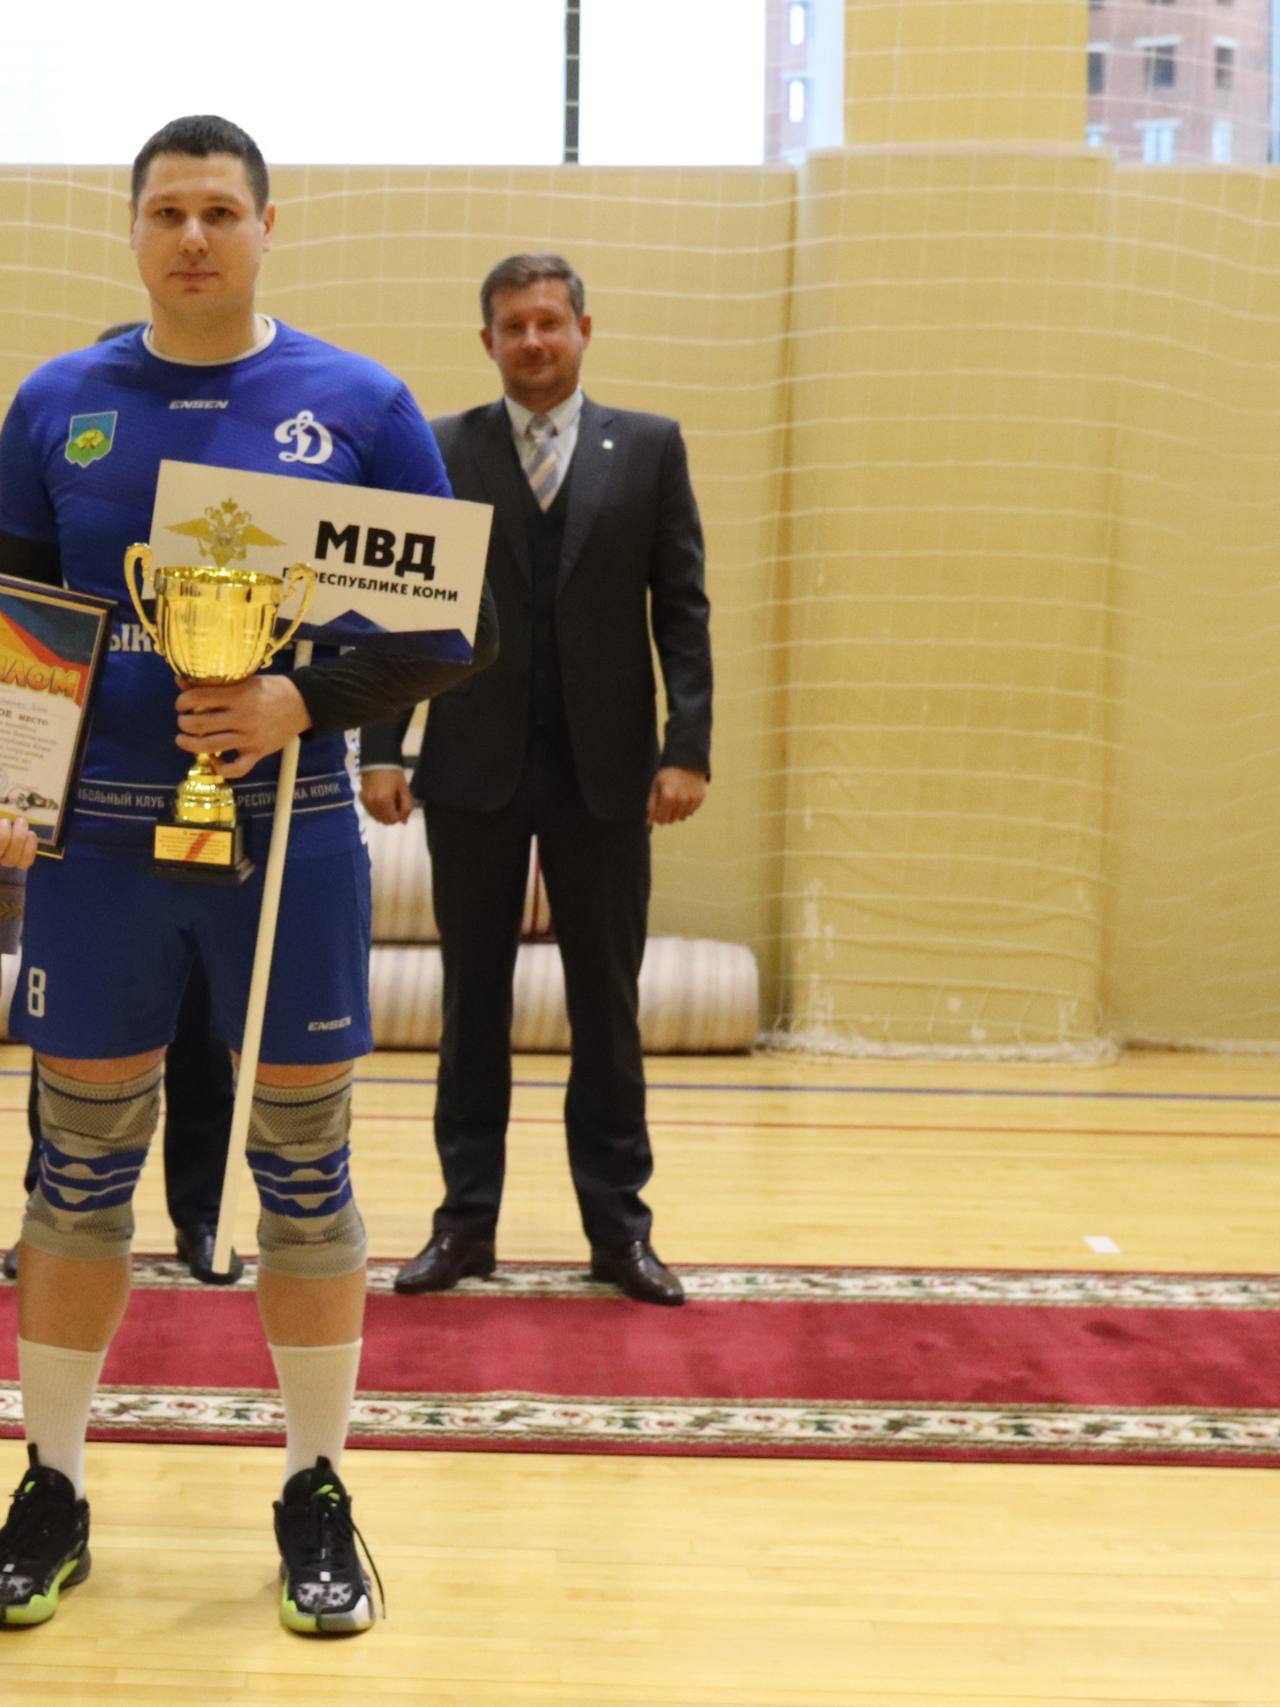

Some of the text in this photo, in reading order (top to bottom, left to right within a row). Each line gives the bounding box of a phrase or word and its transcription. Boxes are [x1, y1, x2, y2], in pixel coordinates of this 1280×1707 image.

[168, 399, 229, 410] ENSEN
[314, 520, 436, 582] МВД
[314, 571, 408, 596] ЕСПУБЛИКЕ
[412, 585, 458, 602] КОМИ
[135, 794, 165, 809] КЛУБ
[27, 966, 47, 1018] 8
